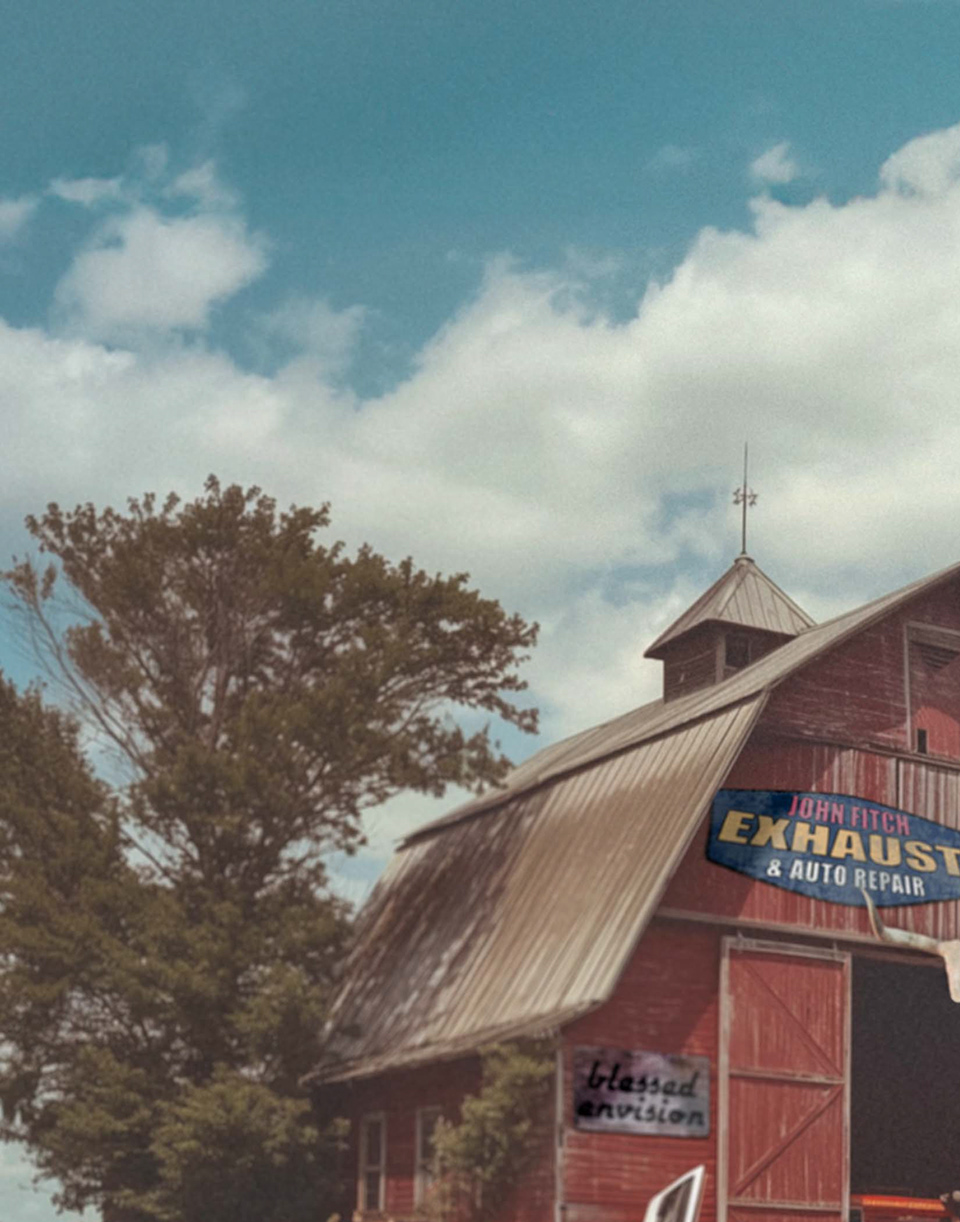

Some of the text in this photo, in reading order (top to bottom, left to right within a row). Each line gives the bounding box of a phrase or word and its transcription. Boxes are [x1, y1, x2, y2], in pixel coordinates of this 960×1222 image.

[788, 796, 910, 835] JOHN FITCH
[767, 860, 925, 896] & AUTO REPAIR
[588, 1061, 699, 1097] blessed
[577, 1097, 705, 1125] envision
